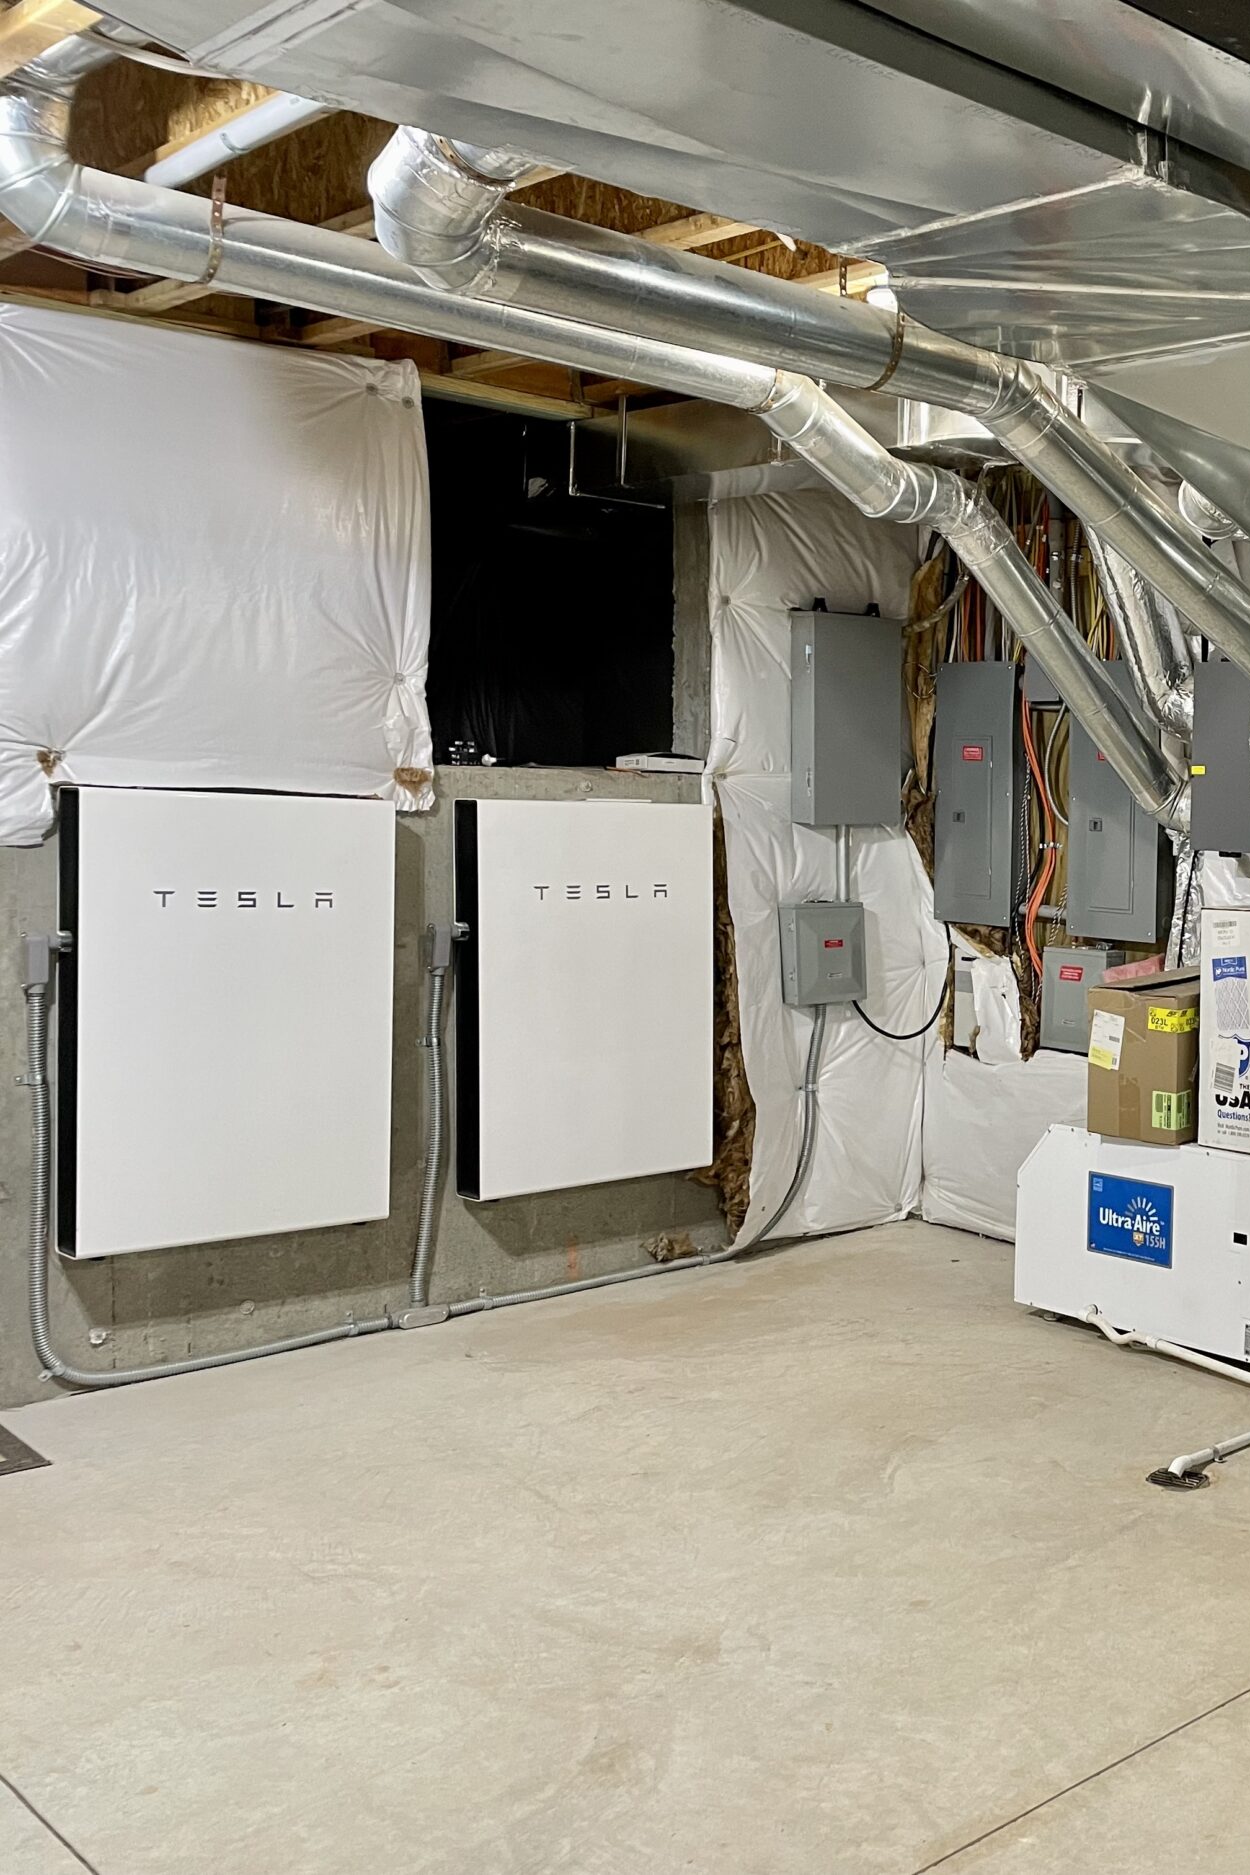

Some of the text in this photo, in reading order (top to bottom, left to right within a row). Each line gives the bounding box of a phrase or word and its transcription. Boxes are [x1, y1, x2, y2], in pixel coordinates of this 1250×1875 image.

[153, 889, 334, 909] TESLA
[532, 883, 669, 902] TESLA
[1145, 1235, 1166, 1249] 155H
